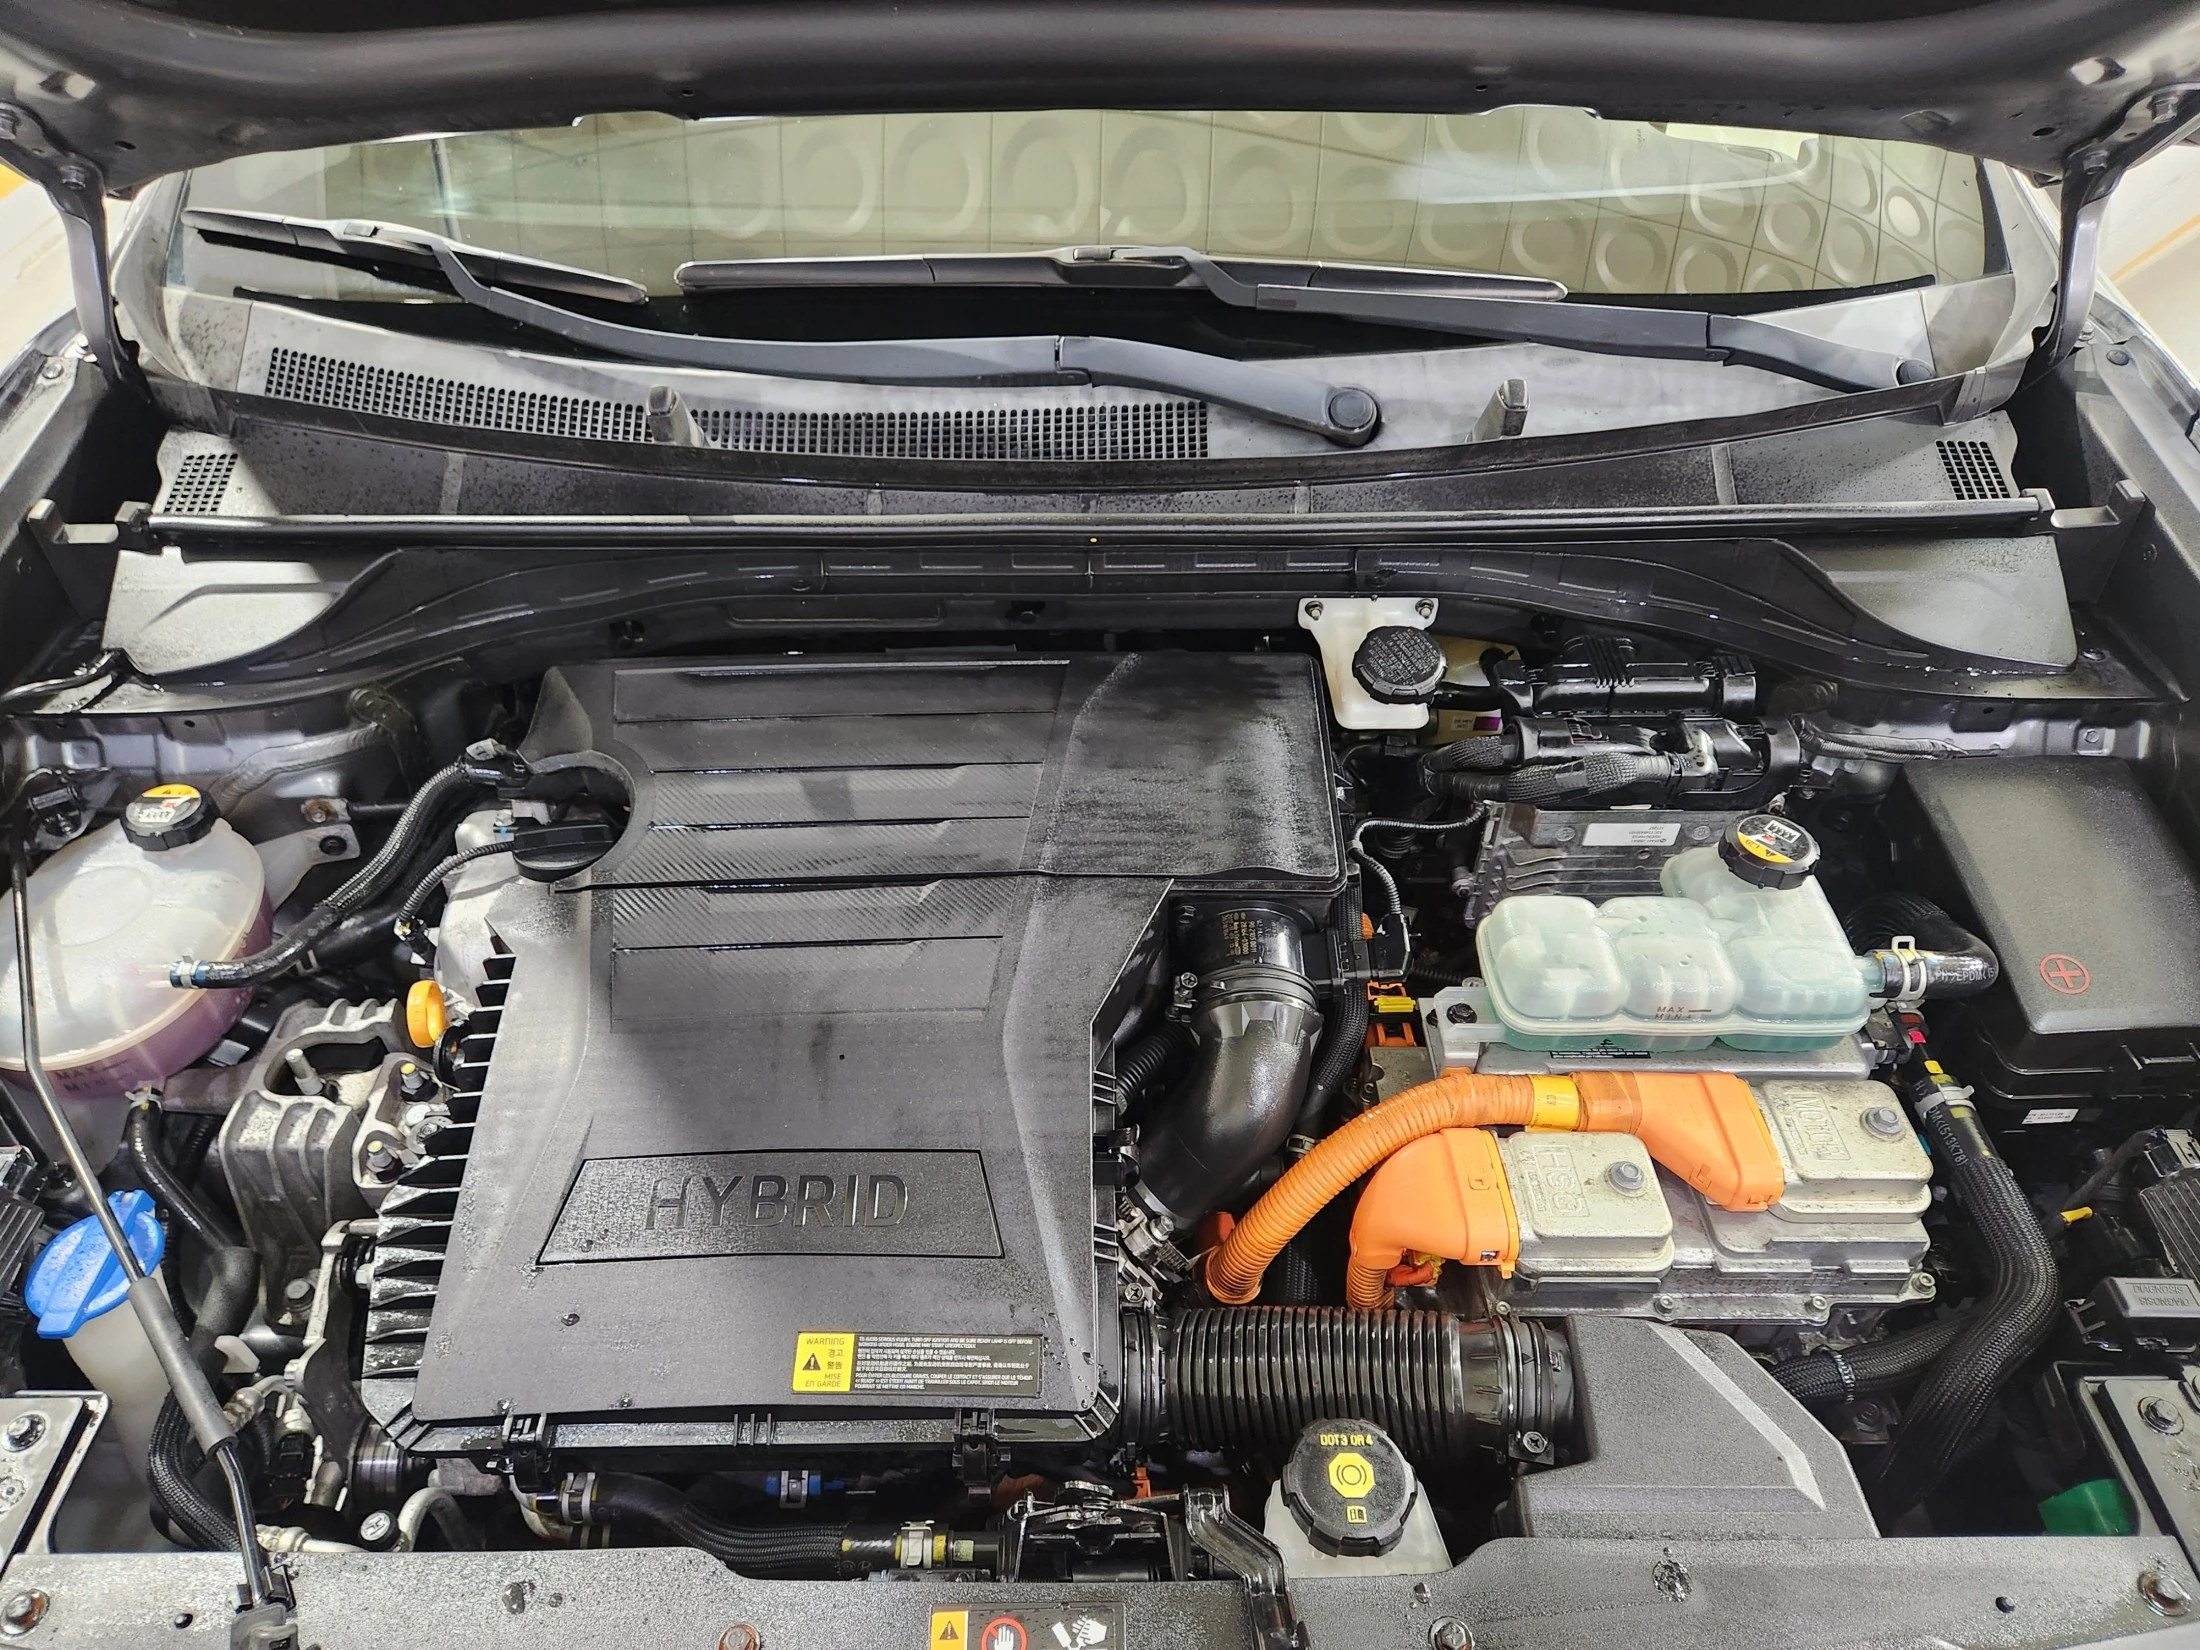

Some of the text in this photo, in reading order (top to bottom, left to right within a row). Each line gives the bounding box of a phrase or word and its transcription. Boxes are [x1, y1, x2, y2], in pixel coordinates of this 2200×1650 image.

[1791, 1096, 1844, 1156] MOTOR
[1538, 1150, 1582, 1212] HSG
[645, 1175, 909, 1230] HYBRID
[2133, 1284, 2184, 1294] DIAGNOSIS
[2139, 1297, 2191, 1307] DIAGNOSIS
[806, 1337, 845, 1345] WARNING
[829, 1348, 844, 1358] 경고
[817, 1380, 841, 1388] GARDE
[1320, 1434, 1374, 1446] DOT3 OR 4
